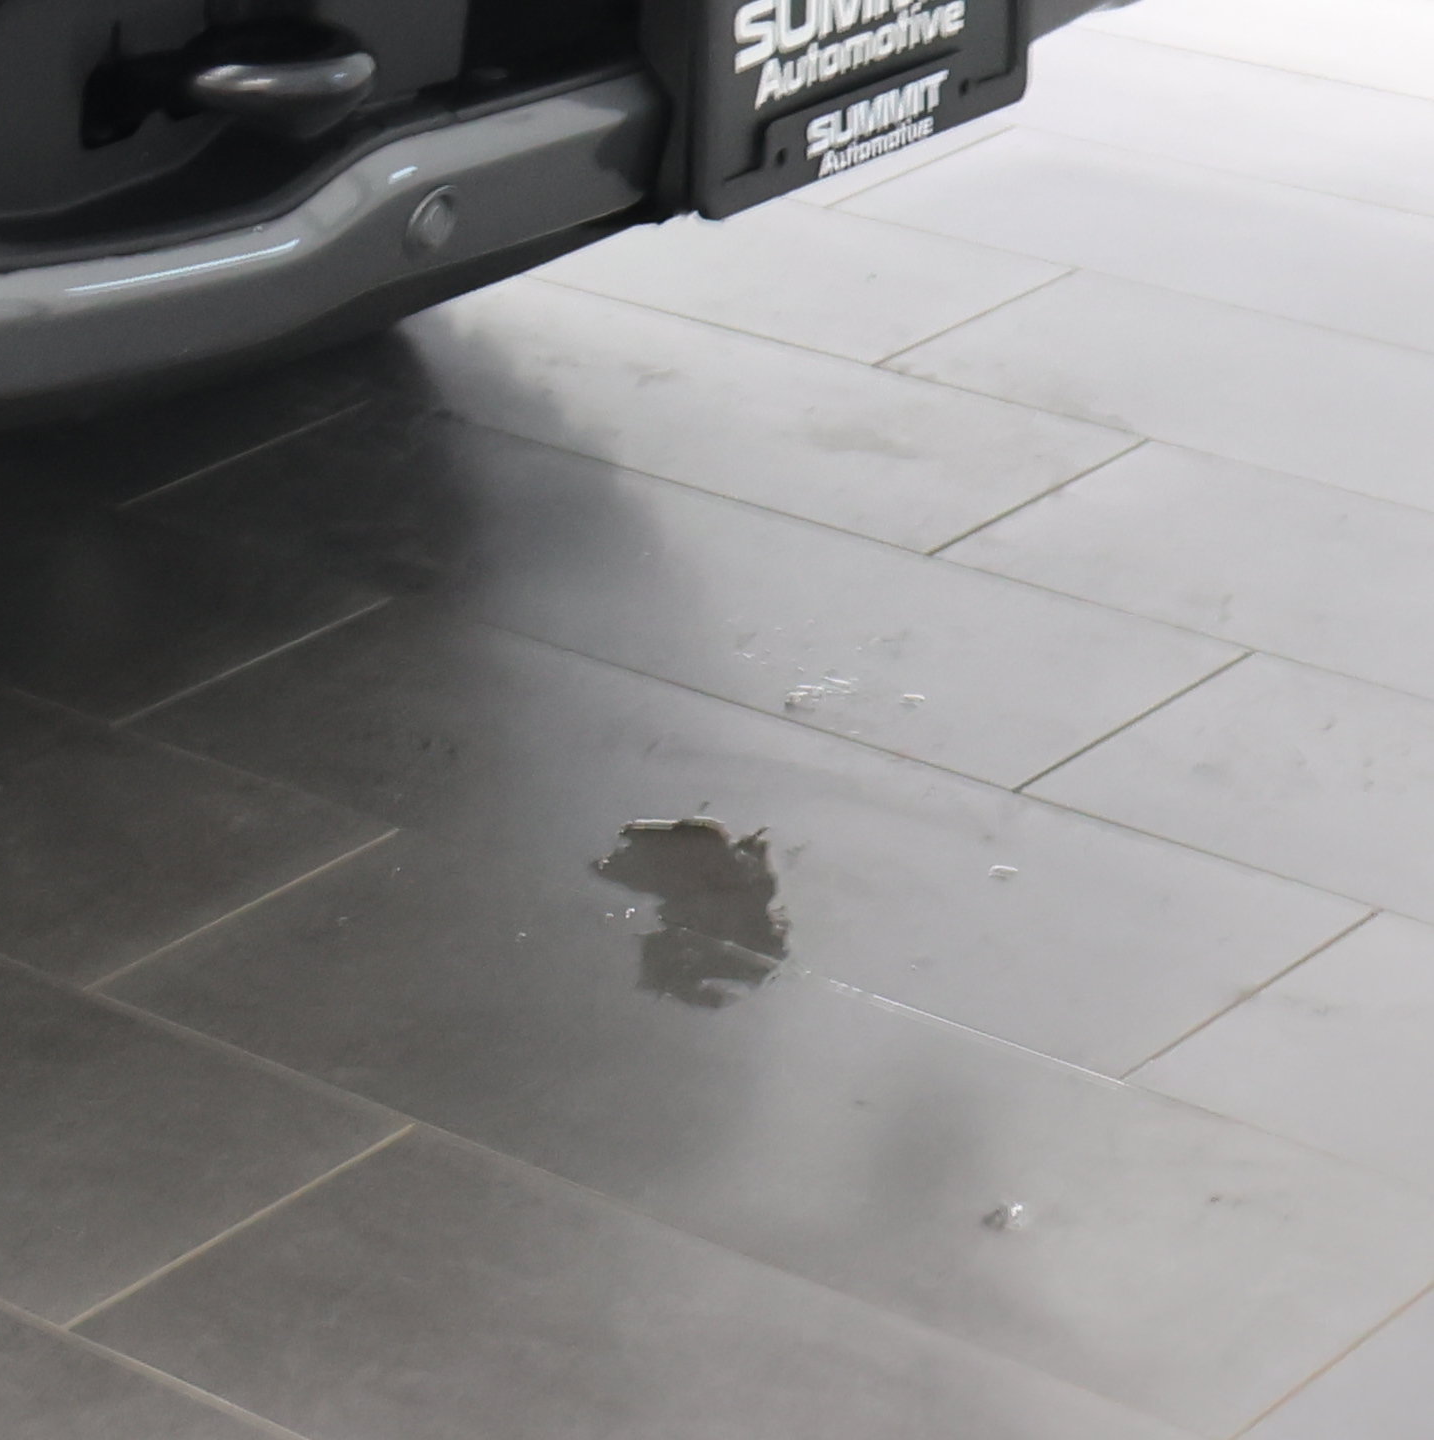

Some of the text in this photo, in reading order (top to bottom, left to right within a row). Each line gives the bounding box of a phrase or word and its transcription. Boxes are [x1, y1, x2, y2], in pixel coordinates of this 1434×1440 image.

[755, 0, 965, 110] Automotive
[806, 69, 949, 160] SUMMIT
[818, 115, 935, 178] Automotive
